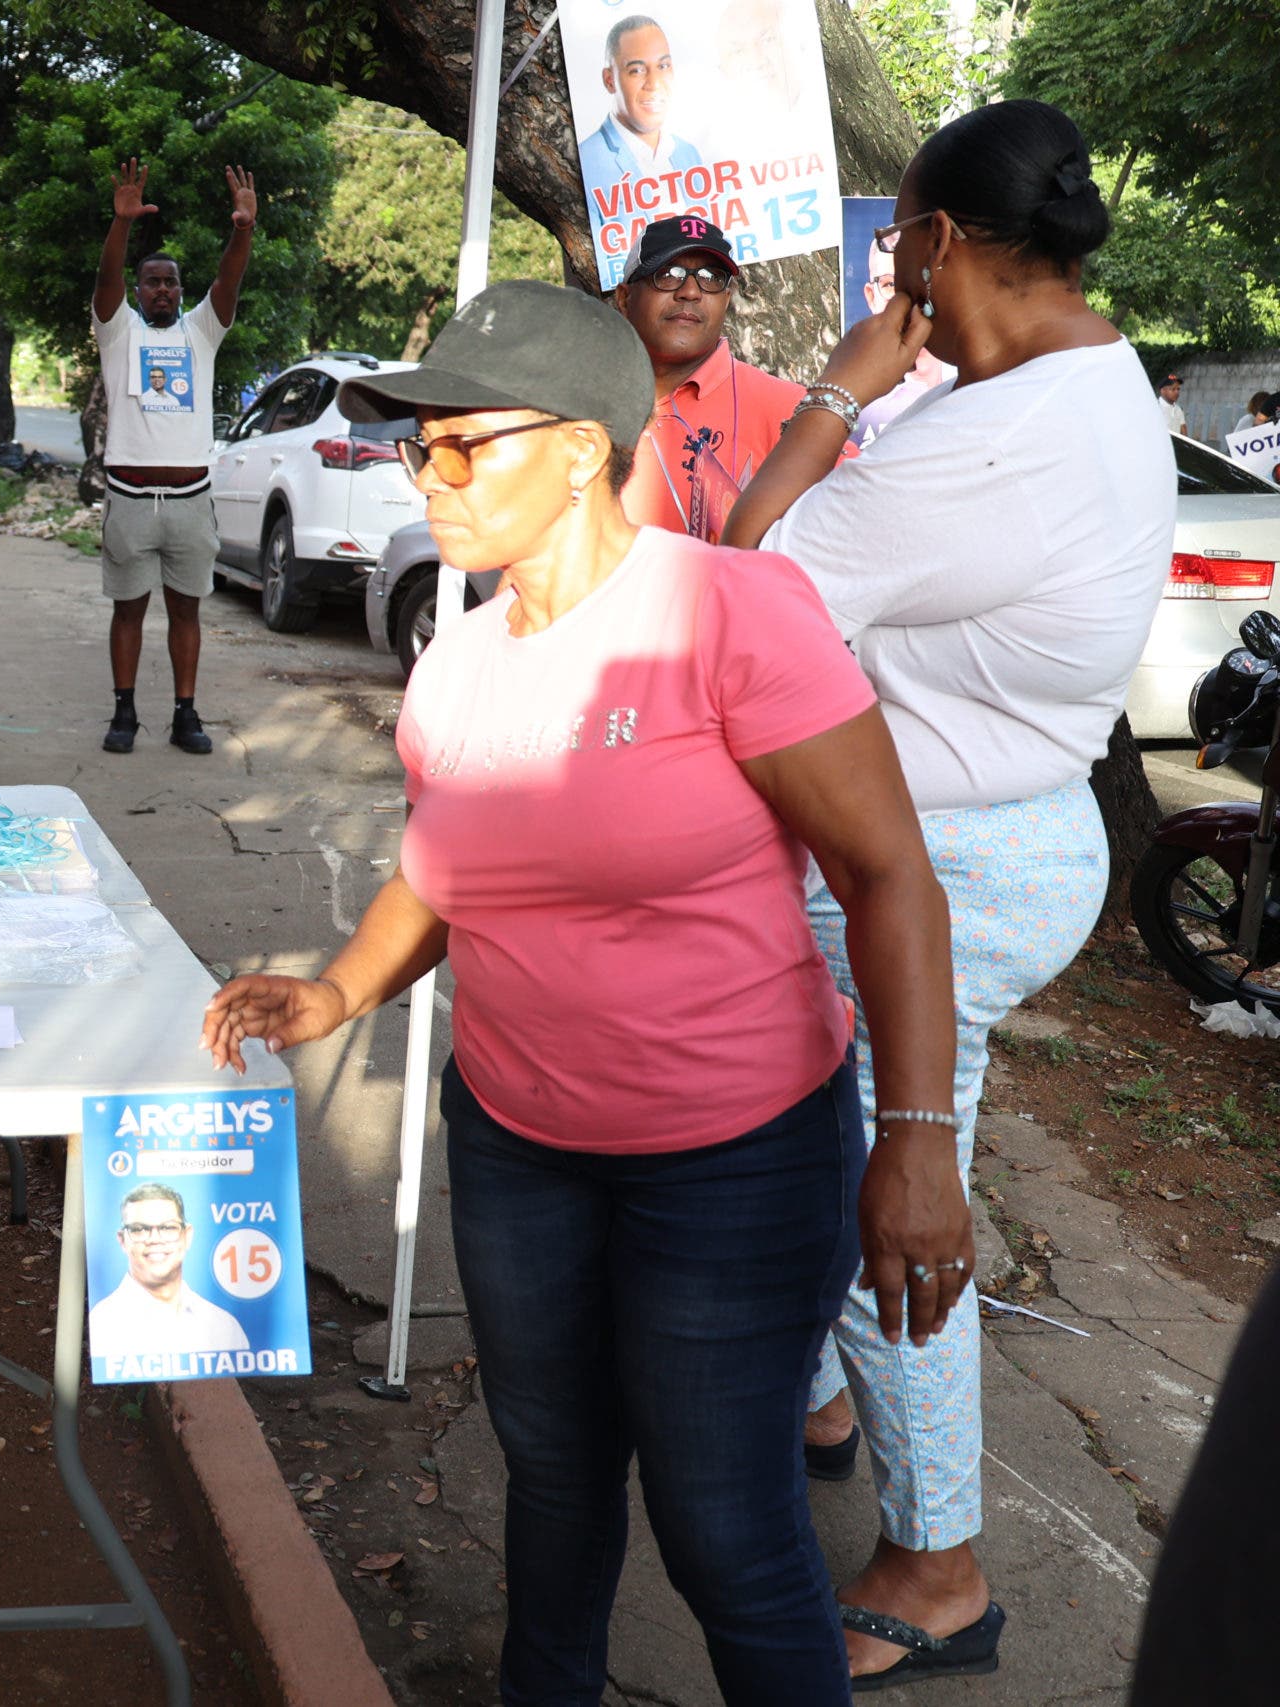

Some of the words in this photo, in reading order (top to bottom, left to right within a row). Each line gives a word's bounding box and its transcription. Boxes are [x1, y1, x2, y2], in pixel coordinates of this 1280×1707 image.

[593, 160, 742, 218] VÍCTOR
[749, 153, 824, 186] VOTA
[600, 192, 750, 255] GAÍA
[763, 189, 822, 240] 13
[148, 349, 186, 358] ARGELYS
[173, 382, 186, 392] 15
[115, 1101, 273, 1137] ARGELYS
[181, 1156, 233, 1169] Regidor
[210, 1202, 276, 1224] VOTA
[220, 1245, 273, 1284] 15
[105, 1349, 297, 1379] FACILITADOR
